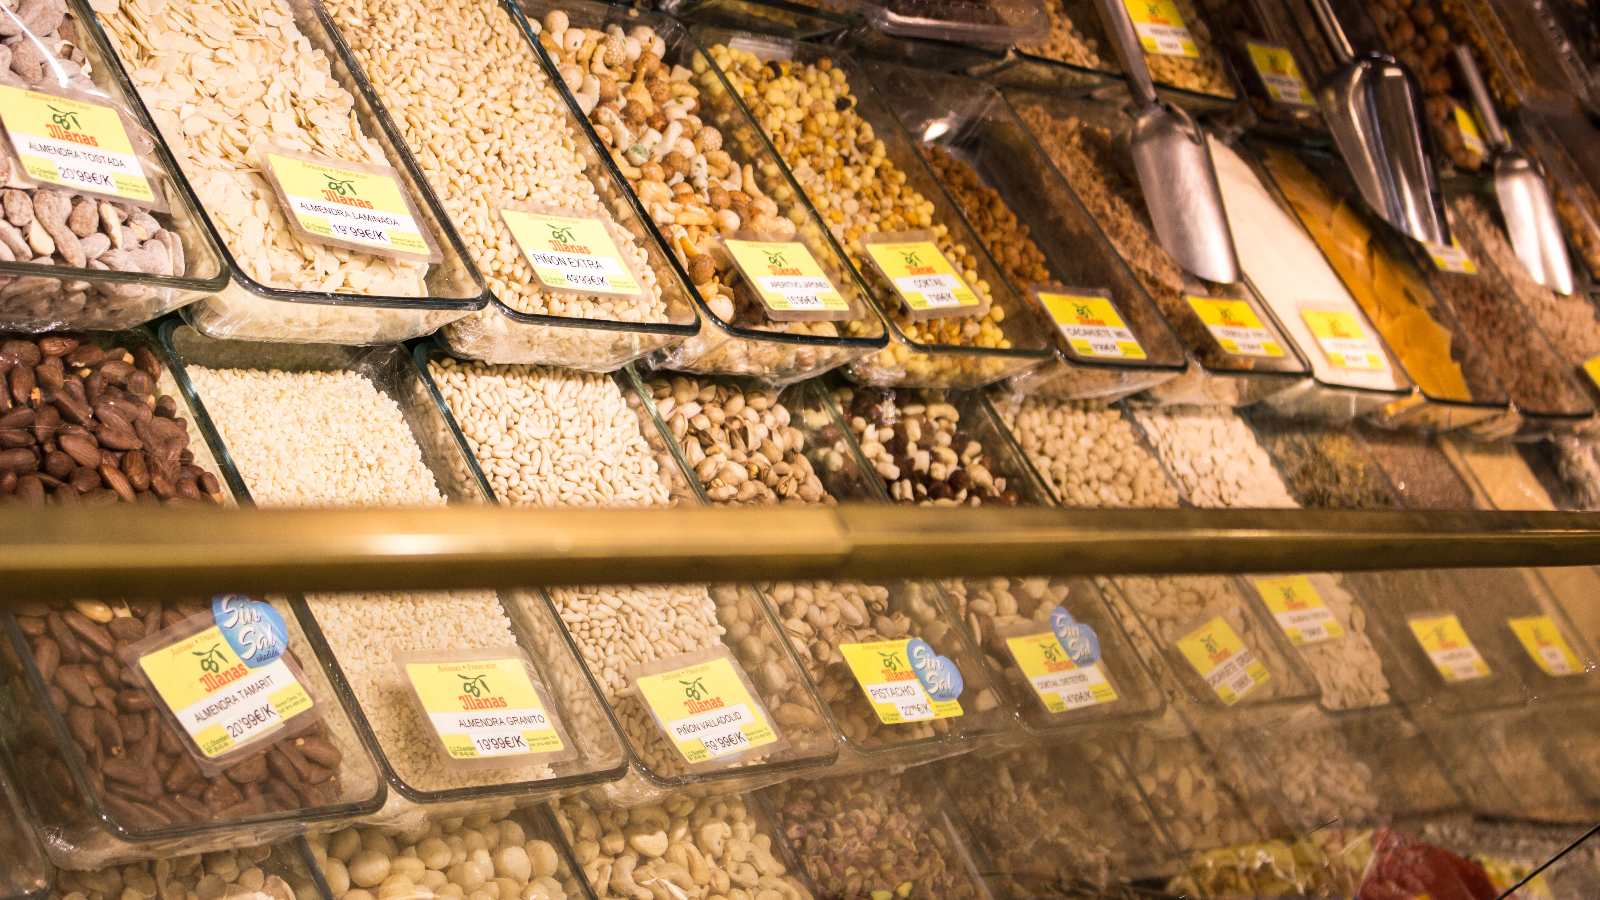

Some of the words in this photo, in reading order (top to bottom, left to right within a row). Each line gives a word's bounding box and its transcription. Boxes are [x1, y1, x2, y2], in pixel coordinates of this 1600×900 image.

[28, 142, 81, 159] ALMENDRA
[82, 151, 127, 168] TOSTADA
[300, 202, 352, 218] ALMENDRA
[353, 211, 401, 226] LAMINADA
[532, 253, 568, 267] PIÑON
[568, 257, 605, 270] EXTRA
[221, 594, 262, 630] Sin
[238, 624, 277, 661] Sal
[913, 645, 944, 671] Sin
[870, 685, 916, 700] PISTACHO
[926, 670, 954, 694] Sal
[194, 693, 241, 723] ALMENDRA
[236, 675, 275, 700] TAMARIT
[226, 703, 277, 738] 20'99€/K
[458, 717, 505, 728] ALMENDRA
[506, 714, 546, 724] GRANITO
[676, 721, 701, 736] PIÑON
[700, 711, 742, 730] VALLADOLID
[476, 735, 526, 751] 19'99€/K
